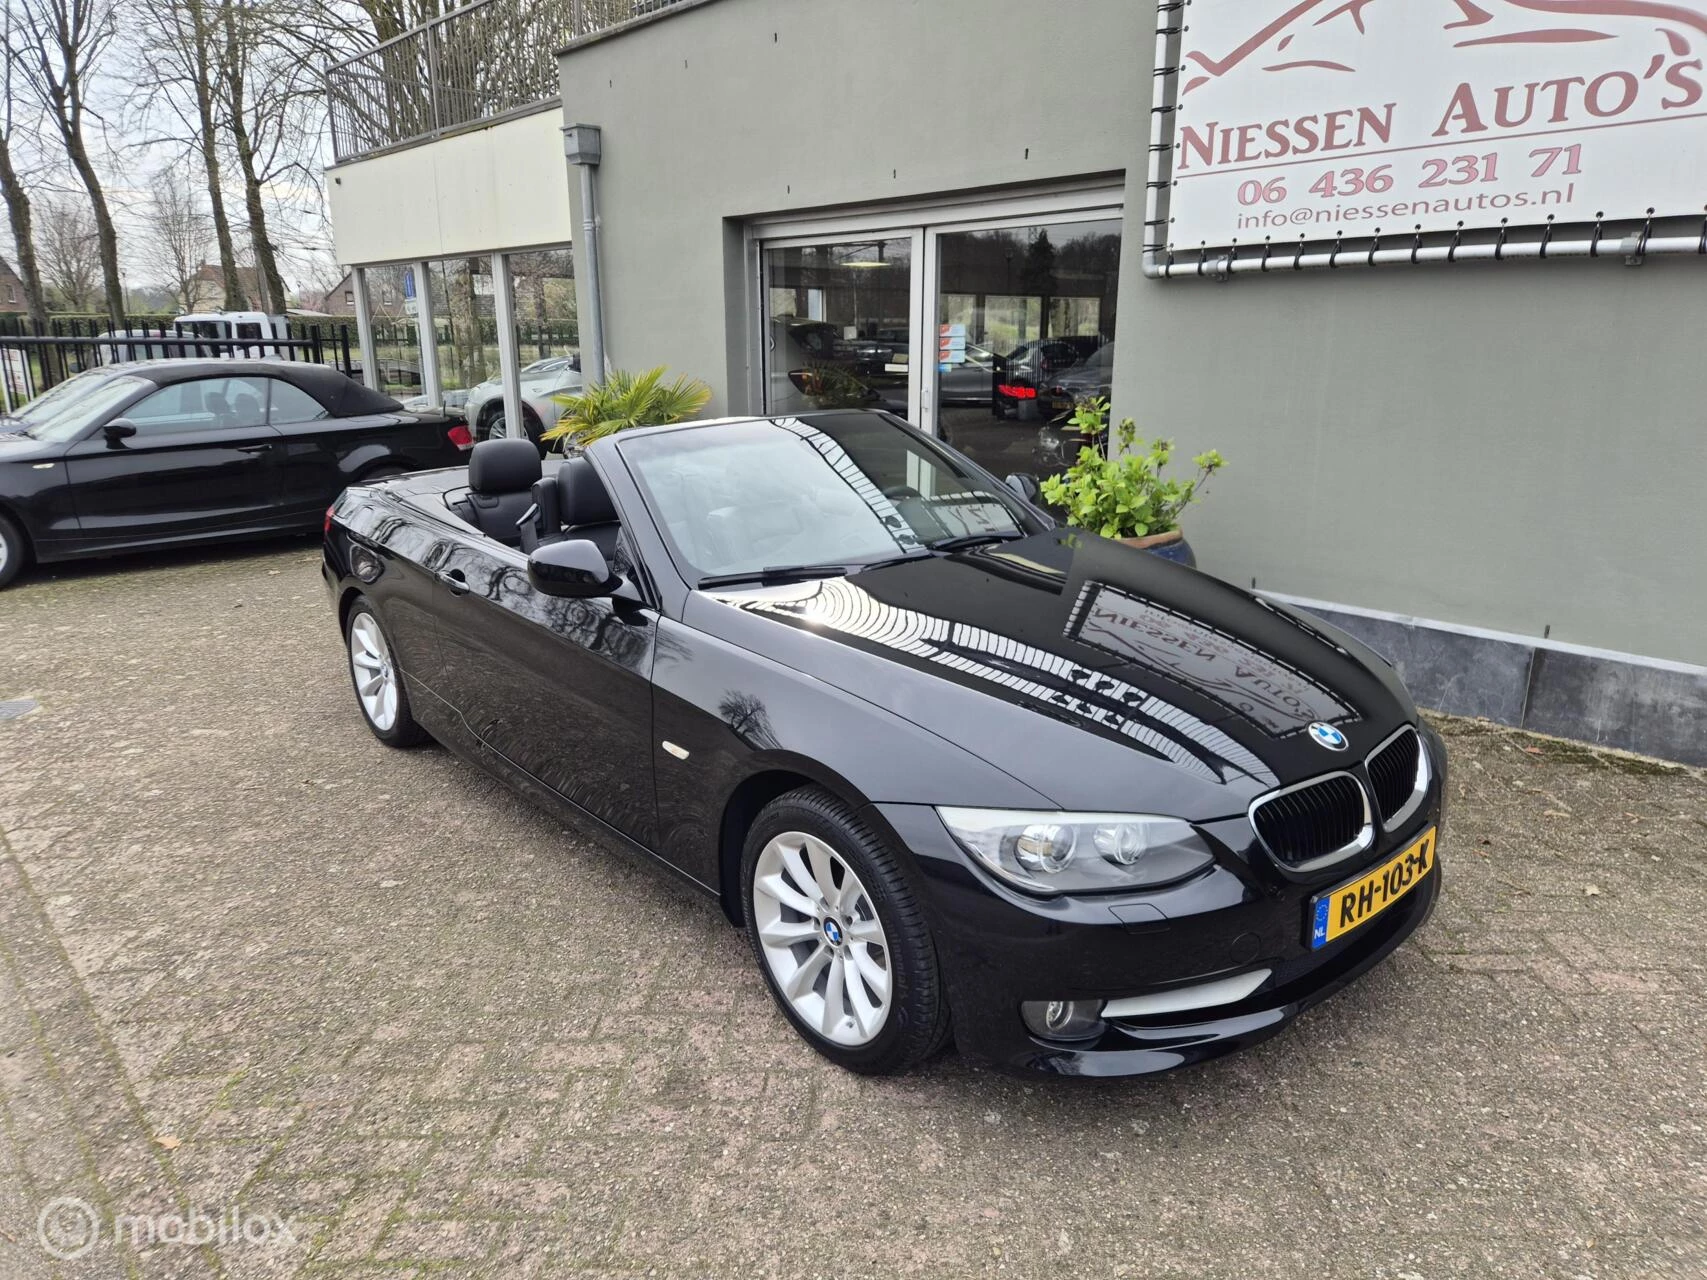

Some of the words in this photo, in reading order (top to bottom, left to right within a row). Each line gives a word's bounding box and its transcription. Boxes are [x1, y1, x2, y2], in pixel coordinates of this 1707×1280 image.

[1177, 103, 1397, 170] NIESSEN
[1236, 175, 1288, 206] 06
[1308, 163, 1395, 199] 436
[1417, 152, 1500, 189] 231
[1528, 143, 1583, 178] 71
[1237, 183, 1575, 230] info@niessenautos.nl
[1313, 926, 1326, 940] NL
